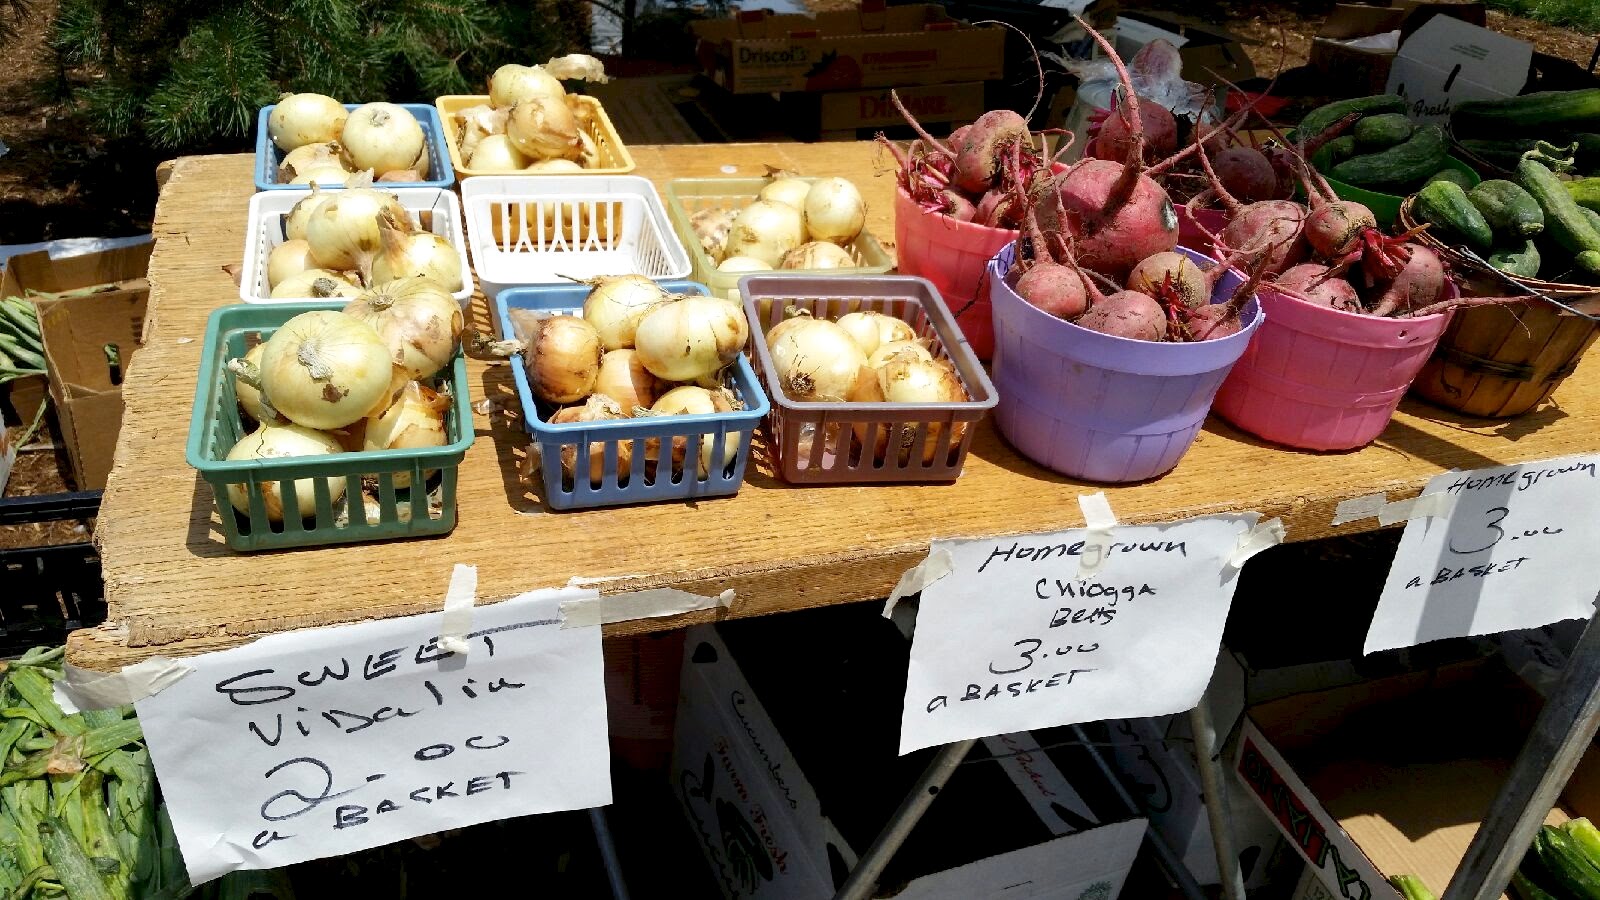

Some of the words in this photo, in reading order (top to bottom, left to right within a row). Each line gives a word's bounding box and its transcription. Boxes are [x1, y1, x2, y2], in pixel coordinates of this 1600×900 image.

[1430, 556, 1529, 587] BASKET
[960, 668, 1098, 702] BASKET
[332, 770, 530, 830] BASKET
